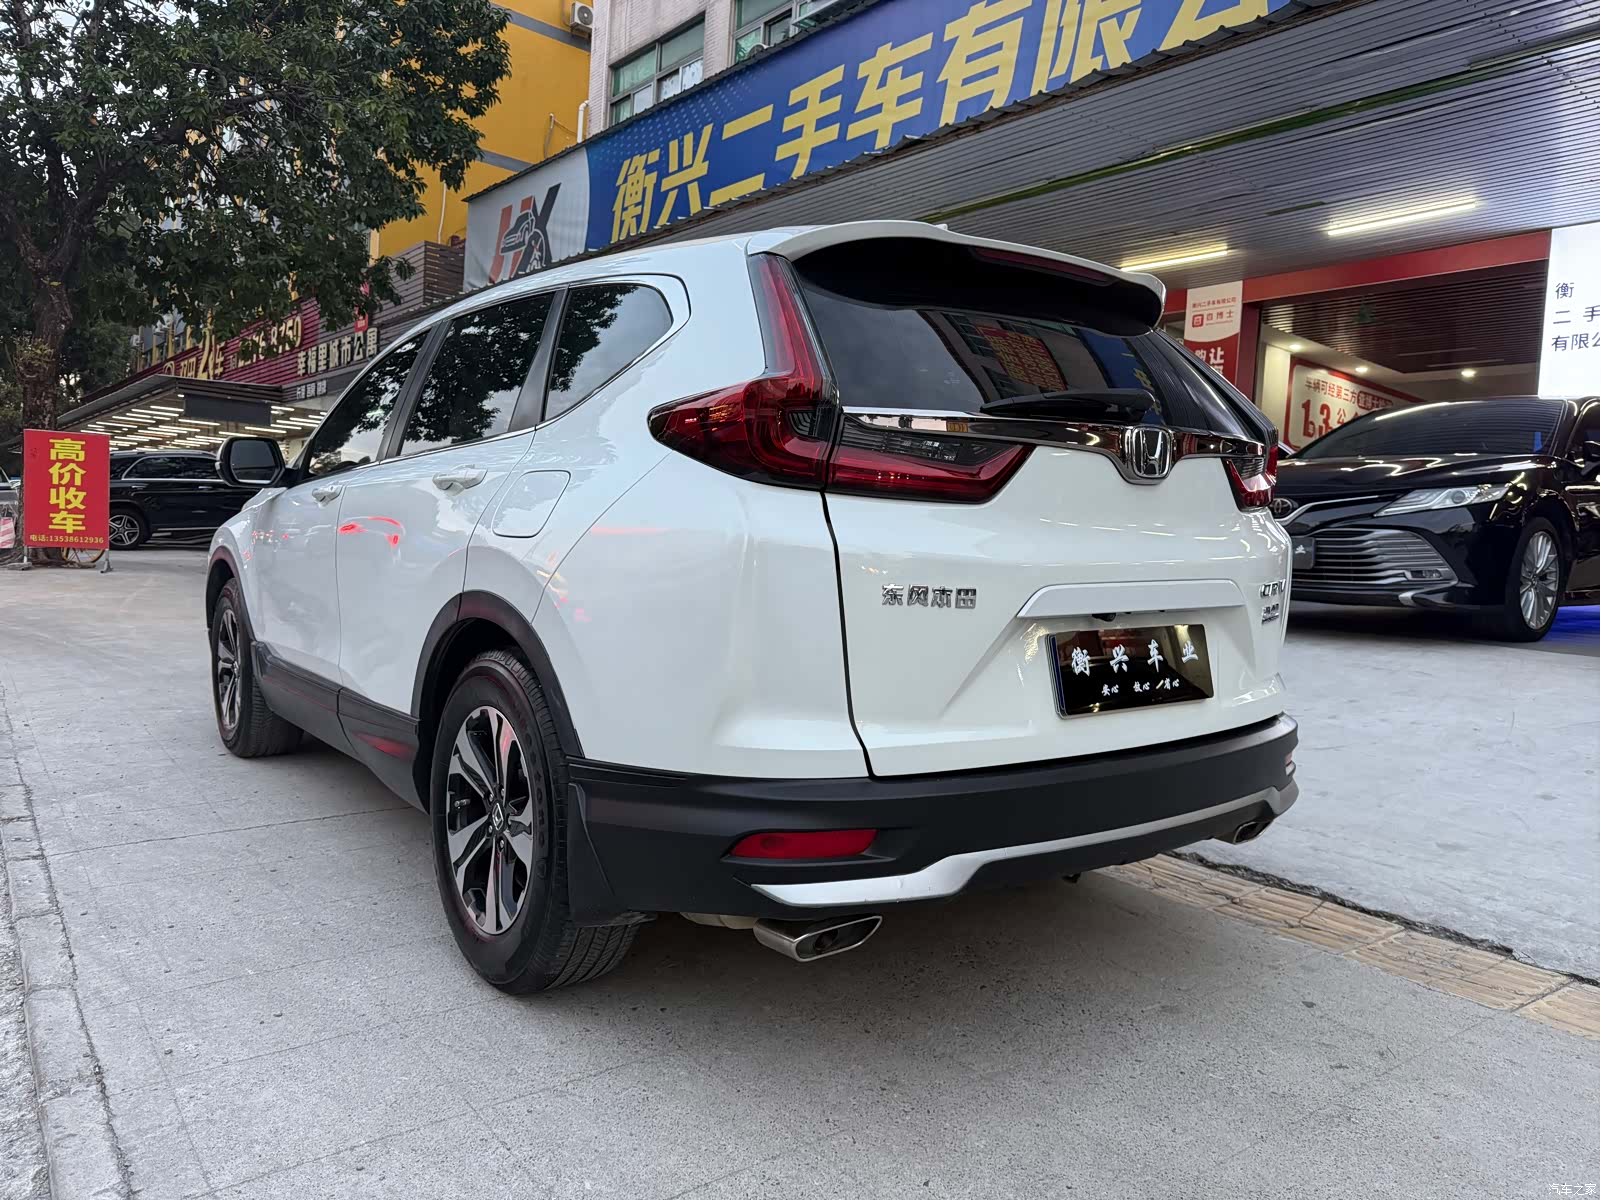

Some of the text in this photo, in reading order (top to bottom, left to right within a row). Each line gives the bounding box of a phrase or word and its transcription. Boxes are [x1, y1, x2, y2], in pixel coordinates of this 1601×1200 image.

[48, 438, 88, 534] 高价收车
[30, 534, 104, 544] 电话:13538612936
[882, 583, 978, 609] 东风本田
